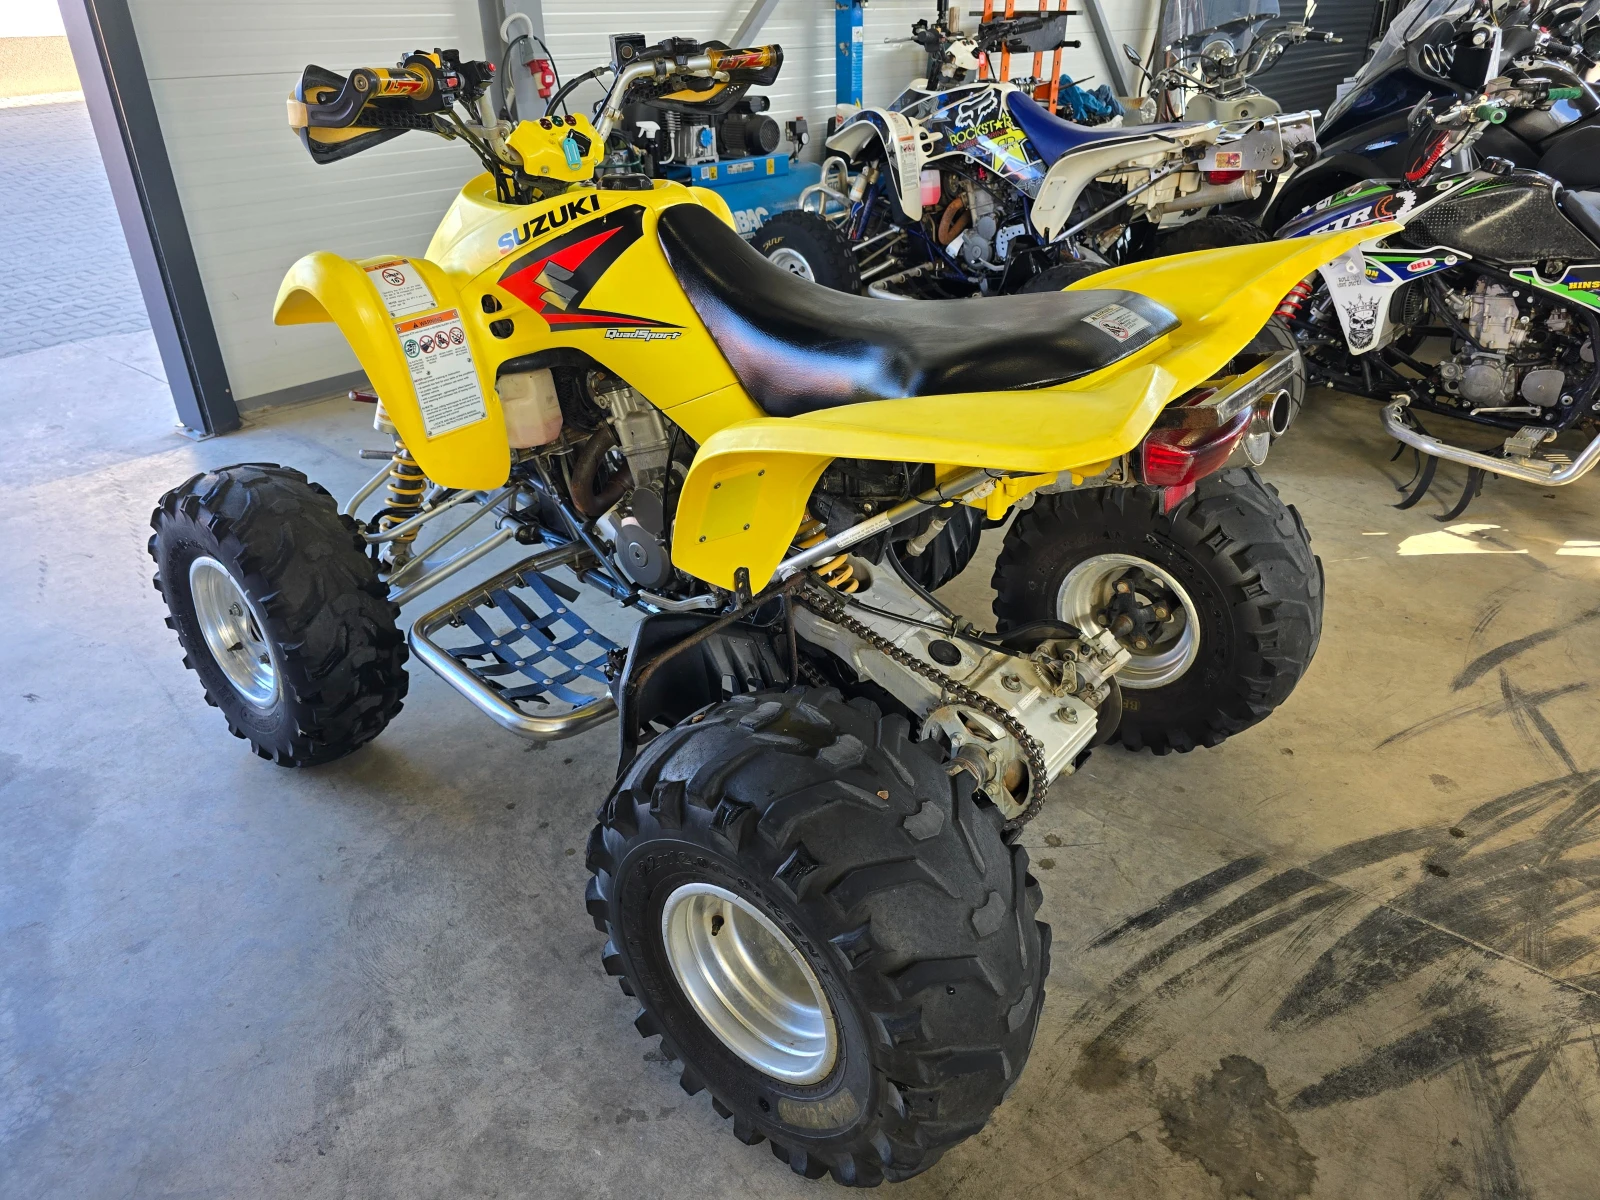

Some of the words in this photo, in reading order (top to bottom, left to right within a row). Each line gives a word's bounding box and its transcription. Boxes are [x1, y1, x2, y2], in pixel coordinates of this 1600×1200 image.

[498, 194, 600, 254] SUZUKI
[733, 206, 769, 234] BAC
[1410, 261, 1432, 272] BELL
[419, 316, 443, 328] WARNING
[605, 328, 681, 341] QuadSport
